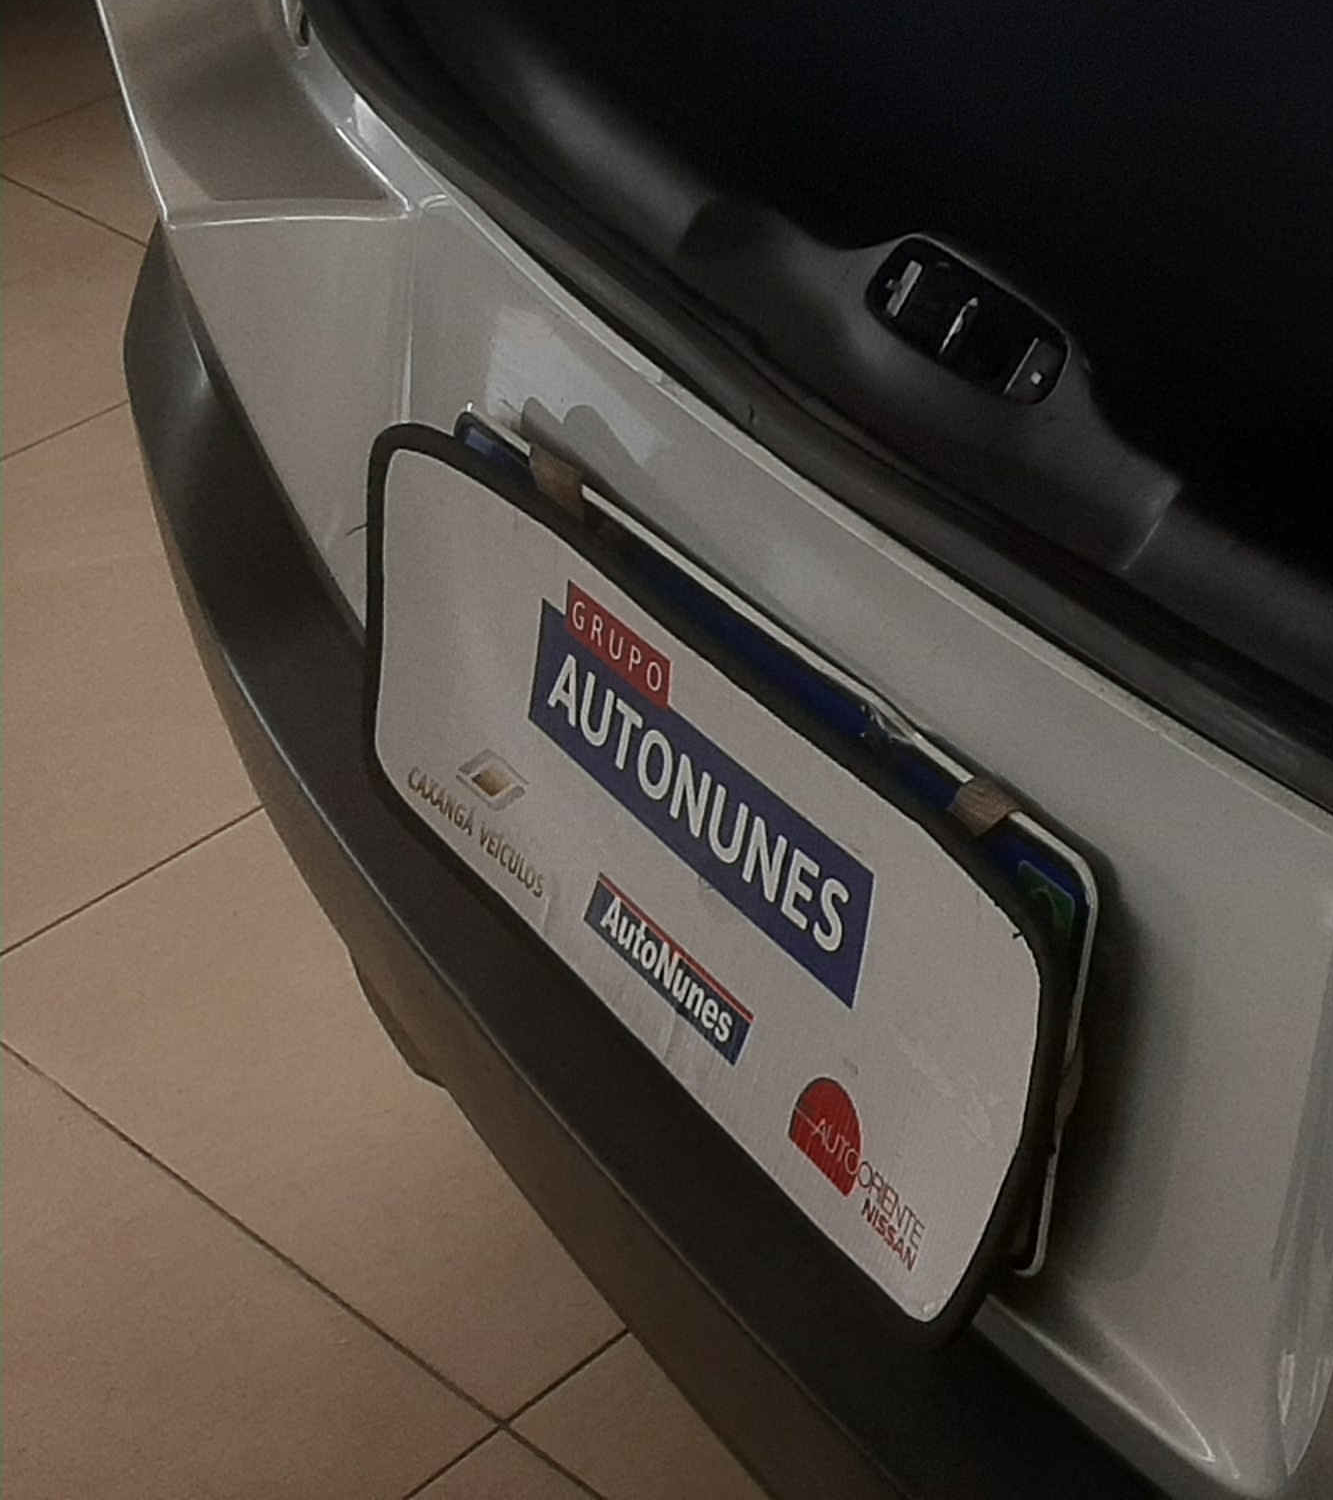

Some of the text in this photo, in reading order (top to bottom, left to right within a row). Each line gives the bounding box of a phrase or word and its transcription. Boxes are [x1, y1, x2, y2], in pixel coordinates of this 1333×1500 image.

[571, 600, 664, 693] GRUPO
[547, 653, 850, 952] AUTONUNES
[600, 895, 734, 1043] AutoNunes
[861, 1198, 917, 1272] NISSAN
